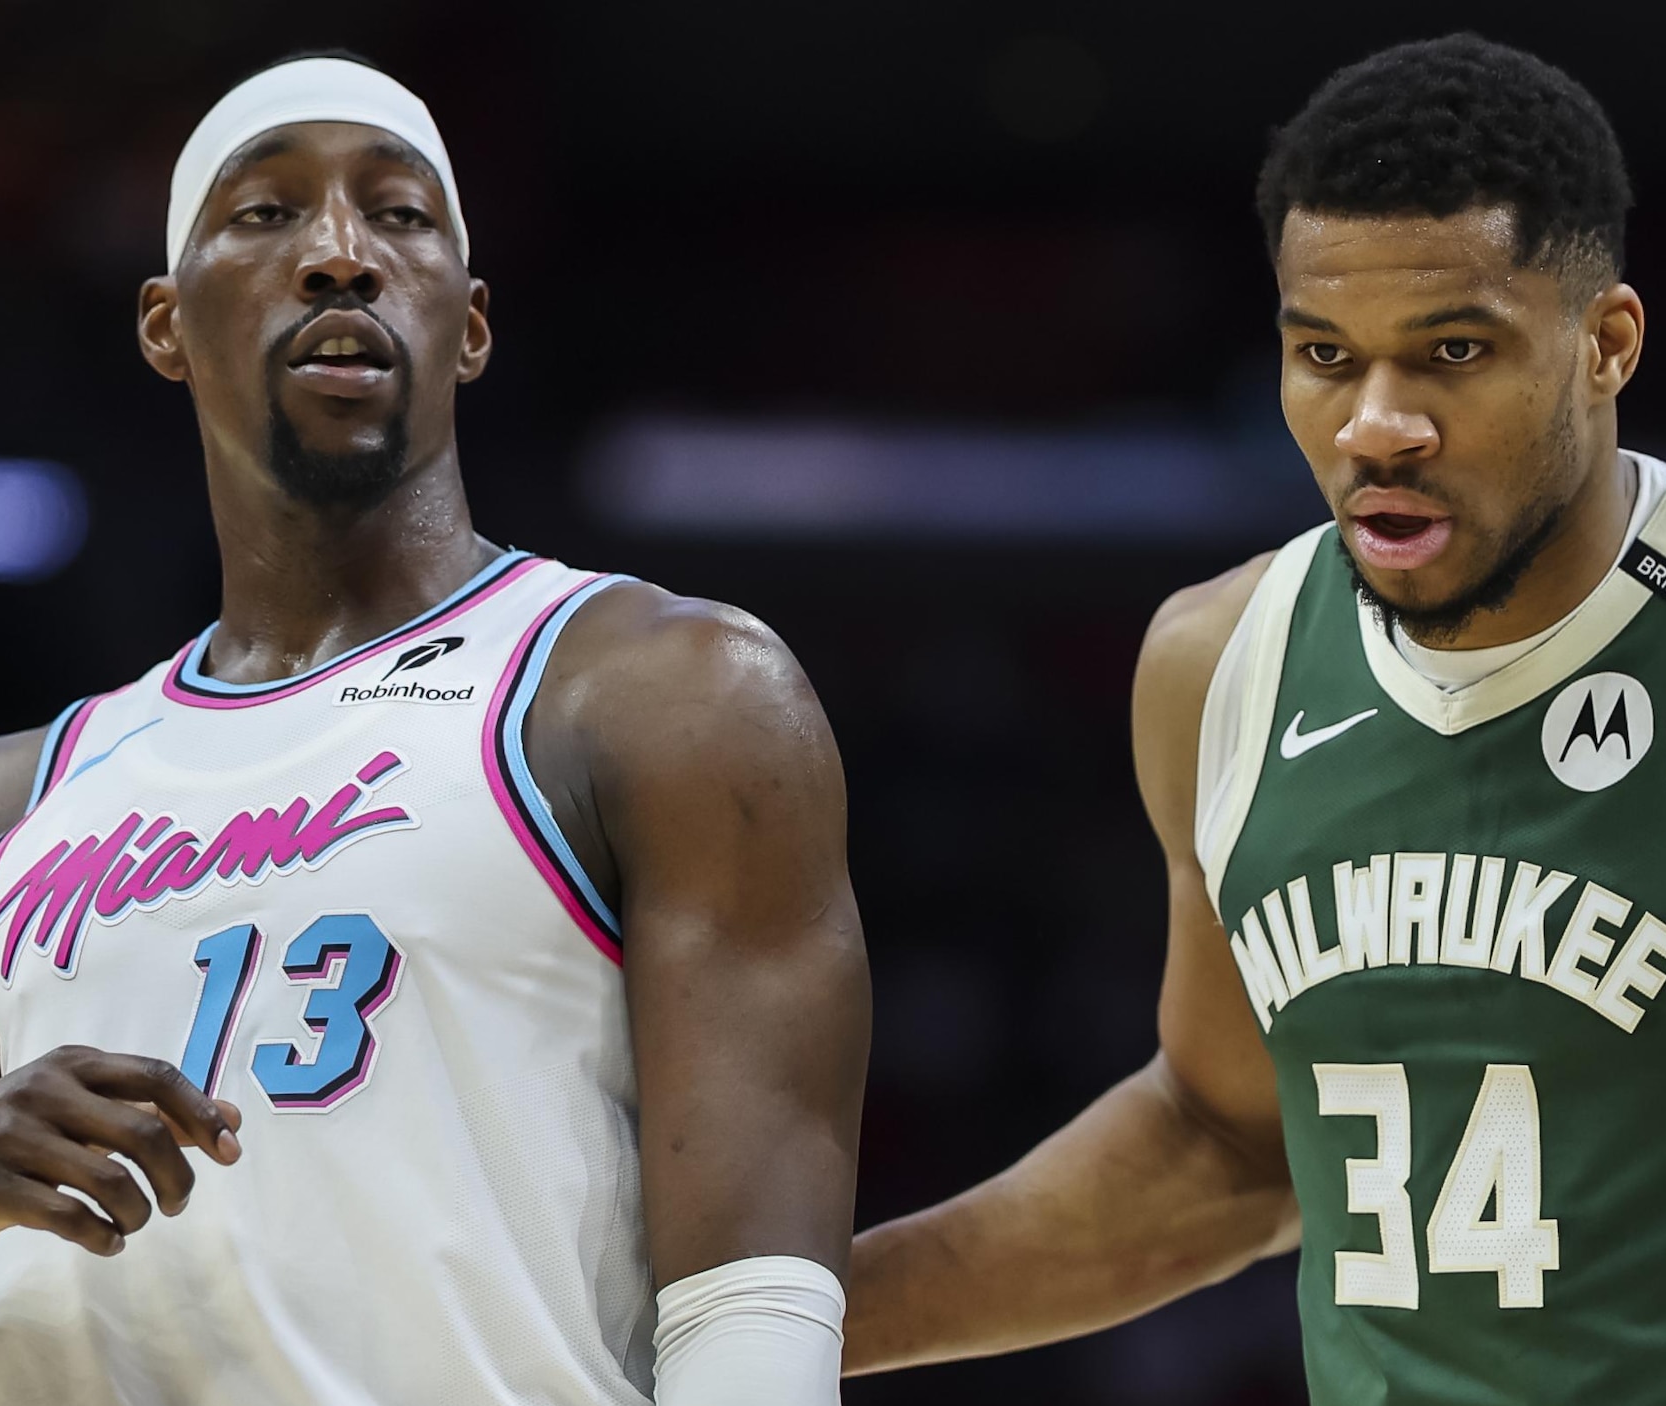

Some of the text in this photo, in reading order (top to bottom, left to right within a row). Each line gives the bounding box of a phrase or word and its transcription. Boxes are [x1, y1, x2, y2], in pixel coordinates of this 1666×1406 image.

[339, 681, 475, 703] Robinhood
[179, 908, 409, 1115] 13
[1312, 1062, 1560, 1310] 34
